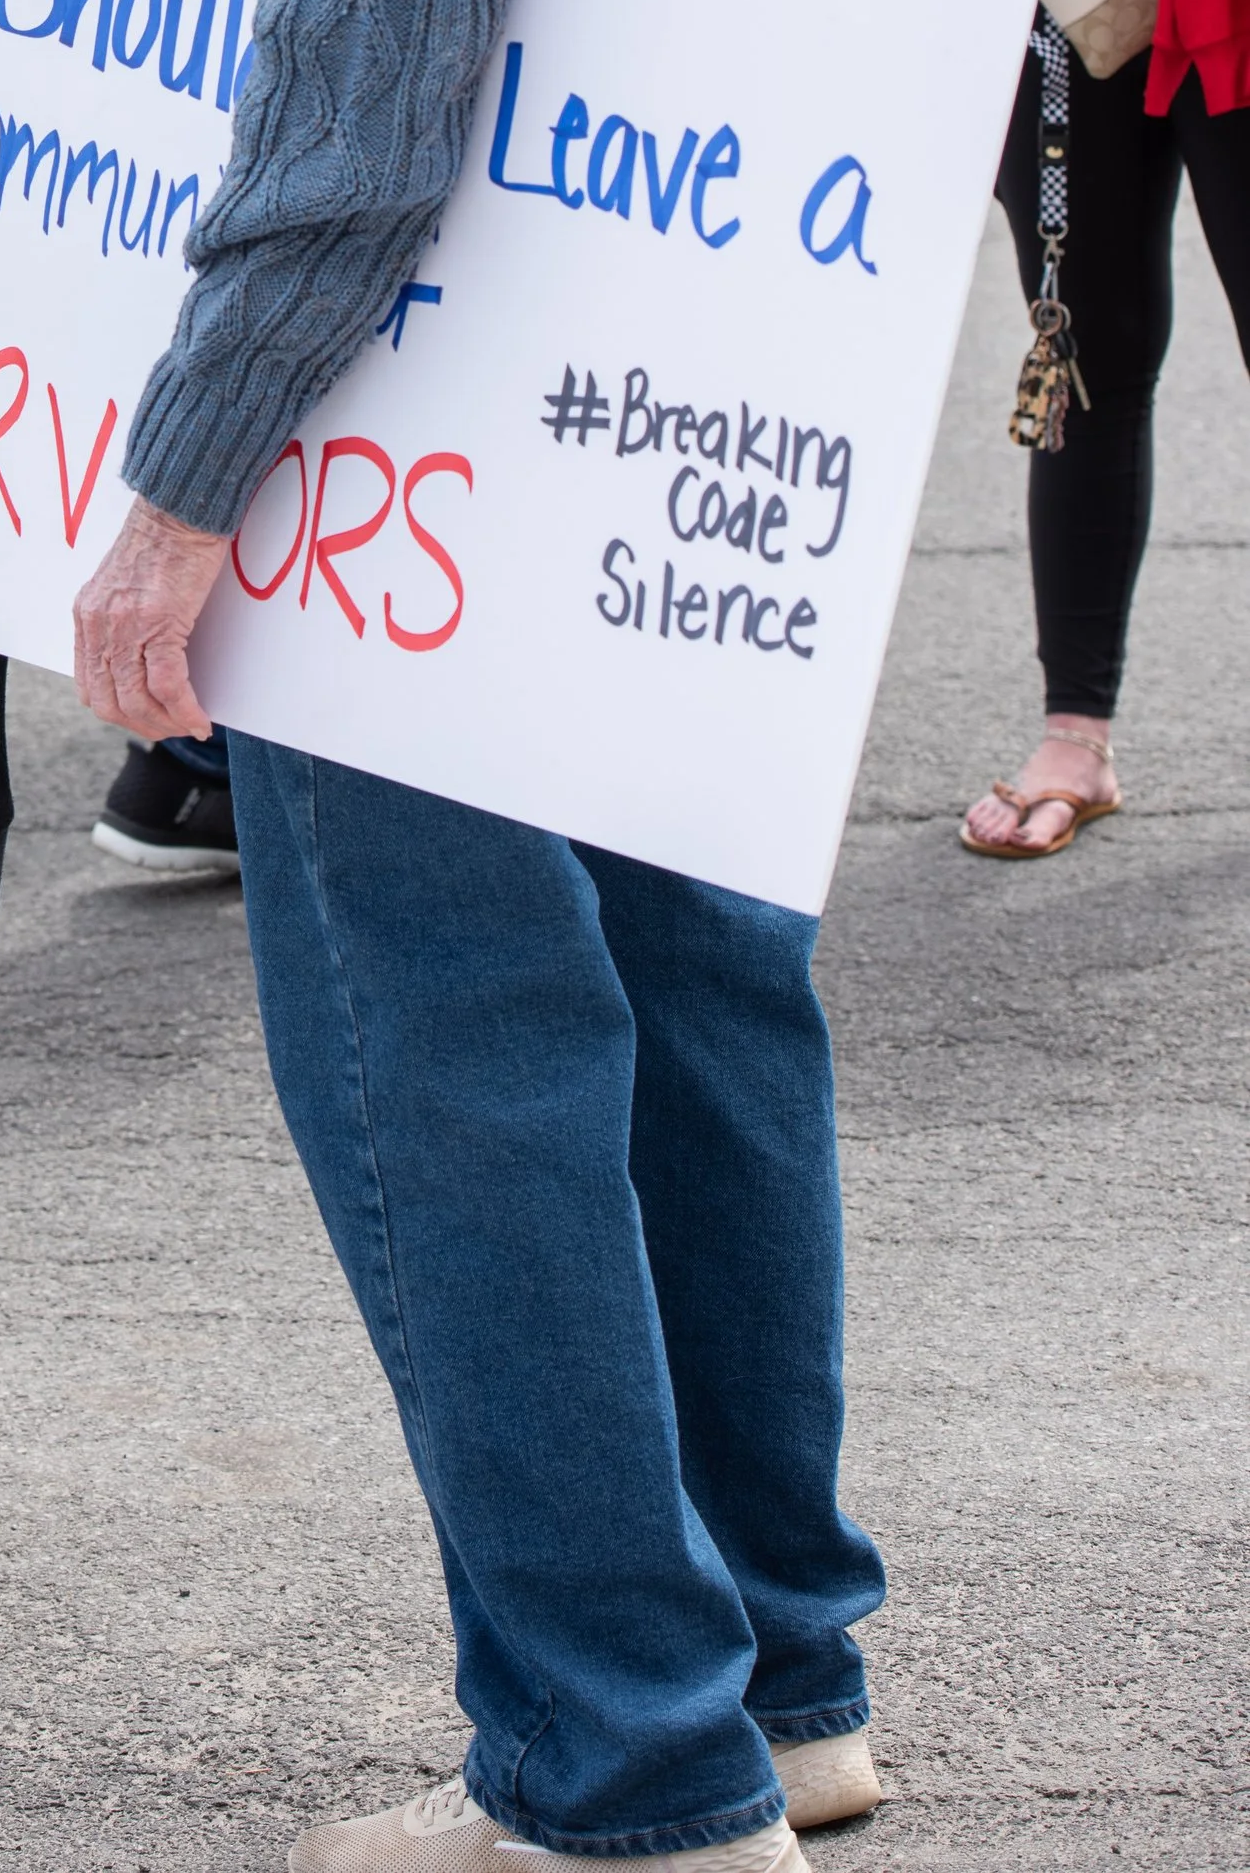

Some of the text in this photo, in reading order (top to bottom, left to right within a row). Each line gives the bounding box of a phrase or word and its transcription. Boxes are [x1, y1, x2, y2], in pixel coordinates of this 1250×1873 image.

[489, 42, 741, 249] Leave
[800, 155, 878, 276] a
[540, 362, 852, 557] #Breaking
[596, 538, 818, 660] Silence
